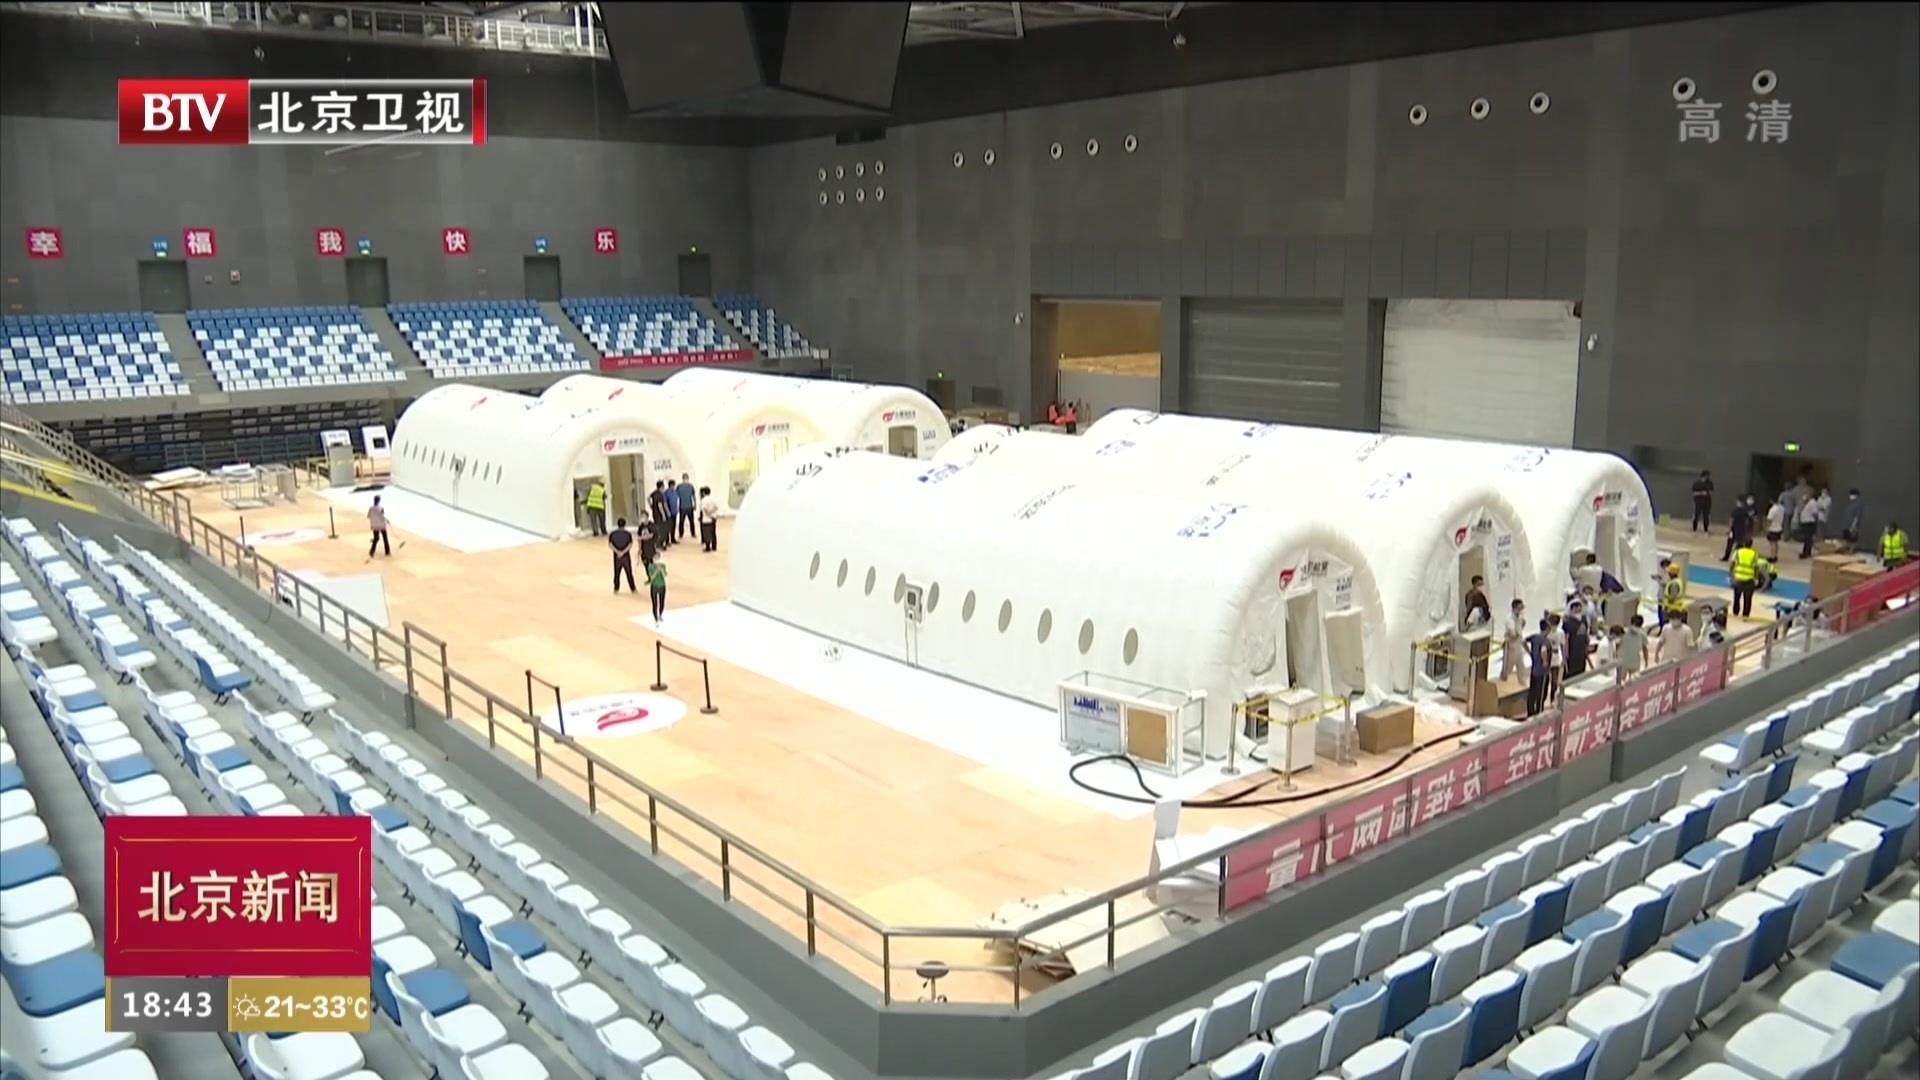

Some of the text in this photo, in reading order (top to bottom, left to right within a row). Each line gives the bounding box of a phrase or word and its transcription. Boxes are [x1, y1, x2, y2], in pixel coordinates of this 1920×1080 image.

[31, 231, 58, 255] 幸
[187, 231, 212, 254] 福
[319, 231, 343, 253] 我
[446, 231, 468, 253] 快
[597, 231, 615, 251] 乐
